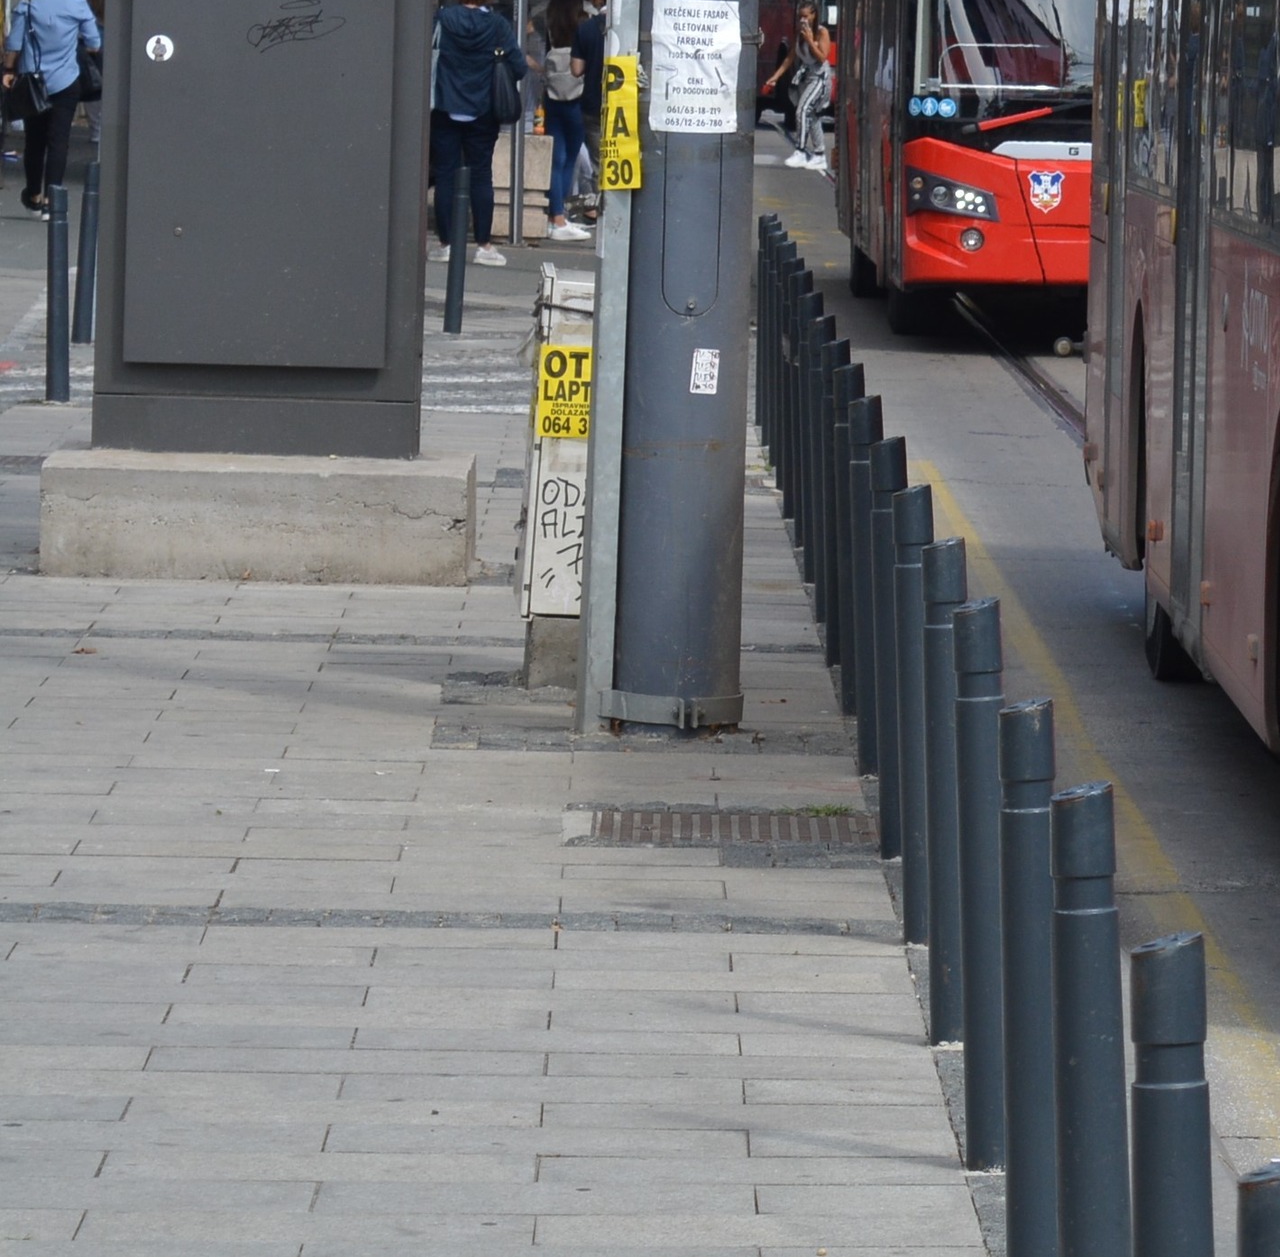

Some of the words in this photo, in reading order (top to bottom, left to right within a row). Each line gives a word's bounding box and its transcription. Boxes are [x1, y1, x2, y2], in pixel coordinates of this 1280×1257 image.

[663, 5, 701, 19] KREČENJE
[703, 9, 729, 20] FASADE
[672, 22, 719, 33] GLETOVANJE
[676, 36, 714, 47] FARBANJE
[687, 77, 704, 85] CENE
[672, 87, 681, 95] PO
[682, 87, 719, 96] DOGOVORU
[666, 104, 721, 115] 061/63-18-219
[664, 117, 723, 127] 063/12-26-780
[606, 159, 633, 186] 30
[541, 415, 571, 434] 064
